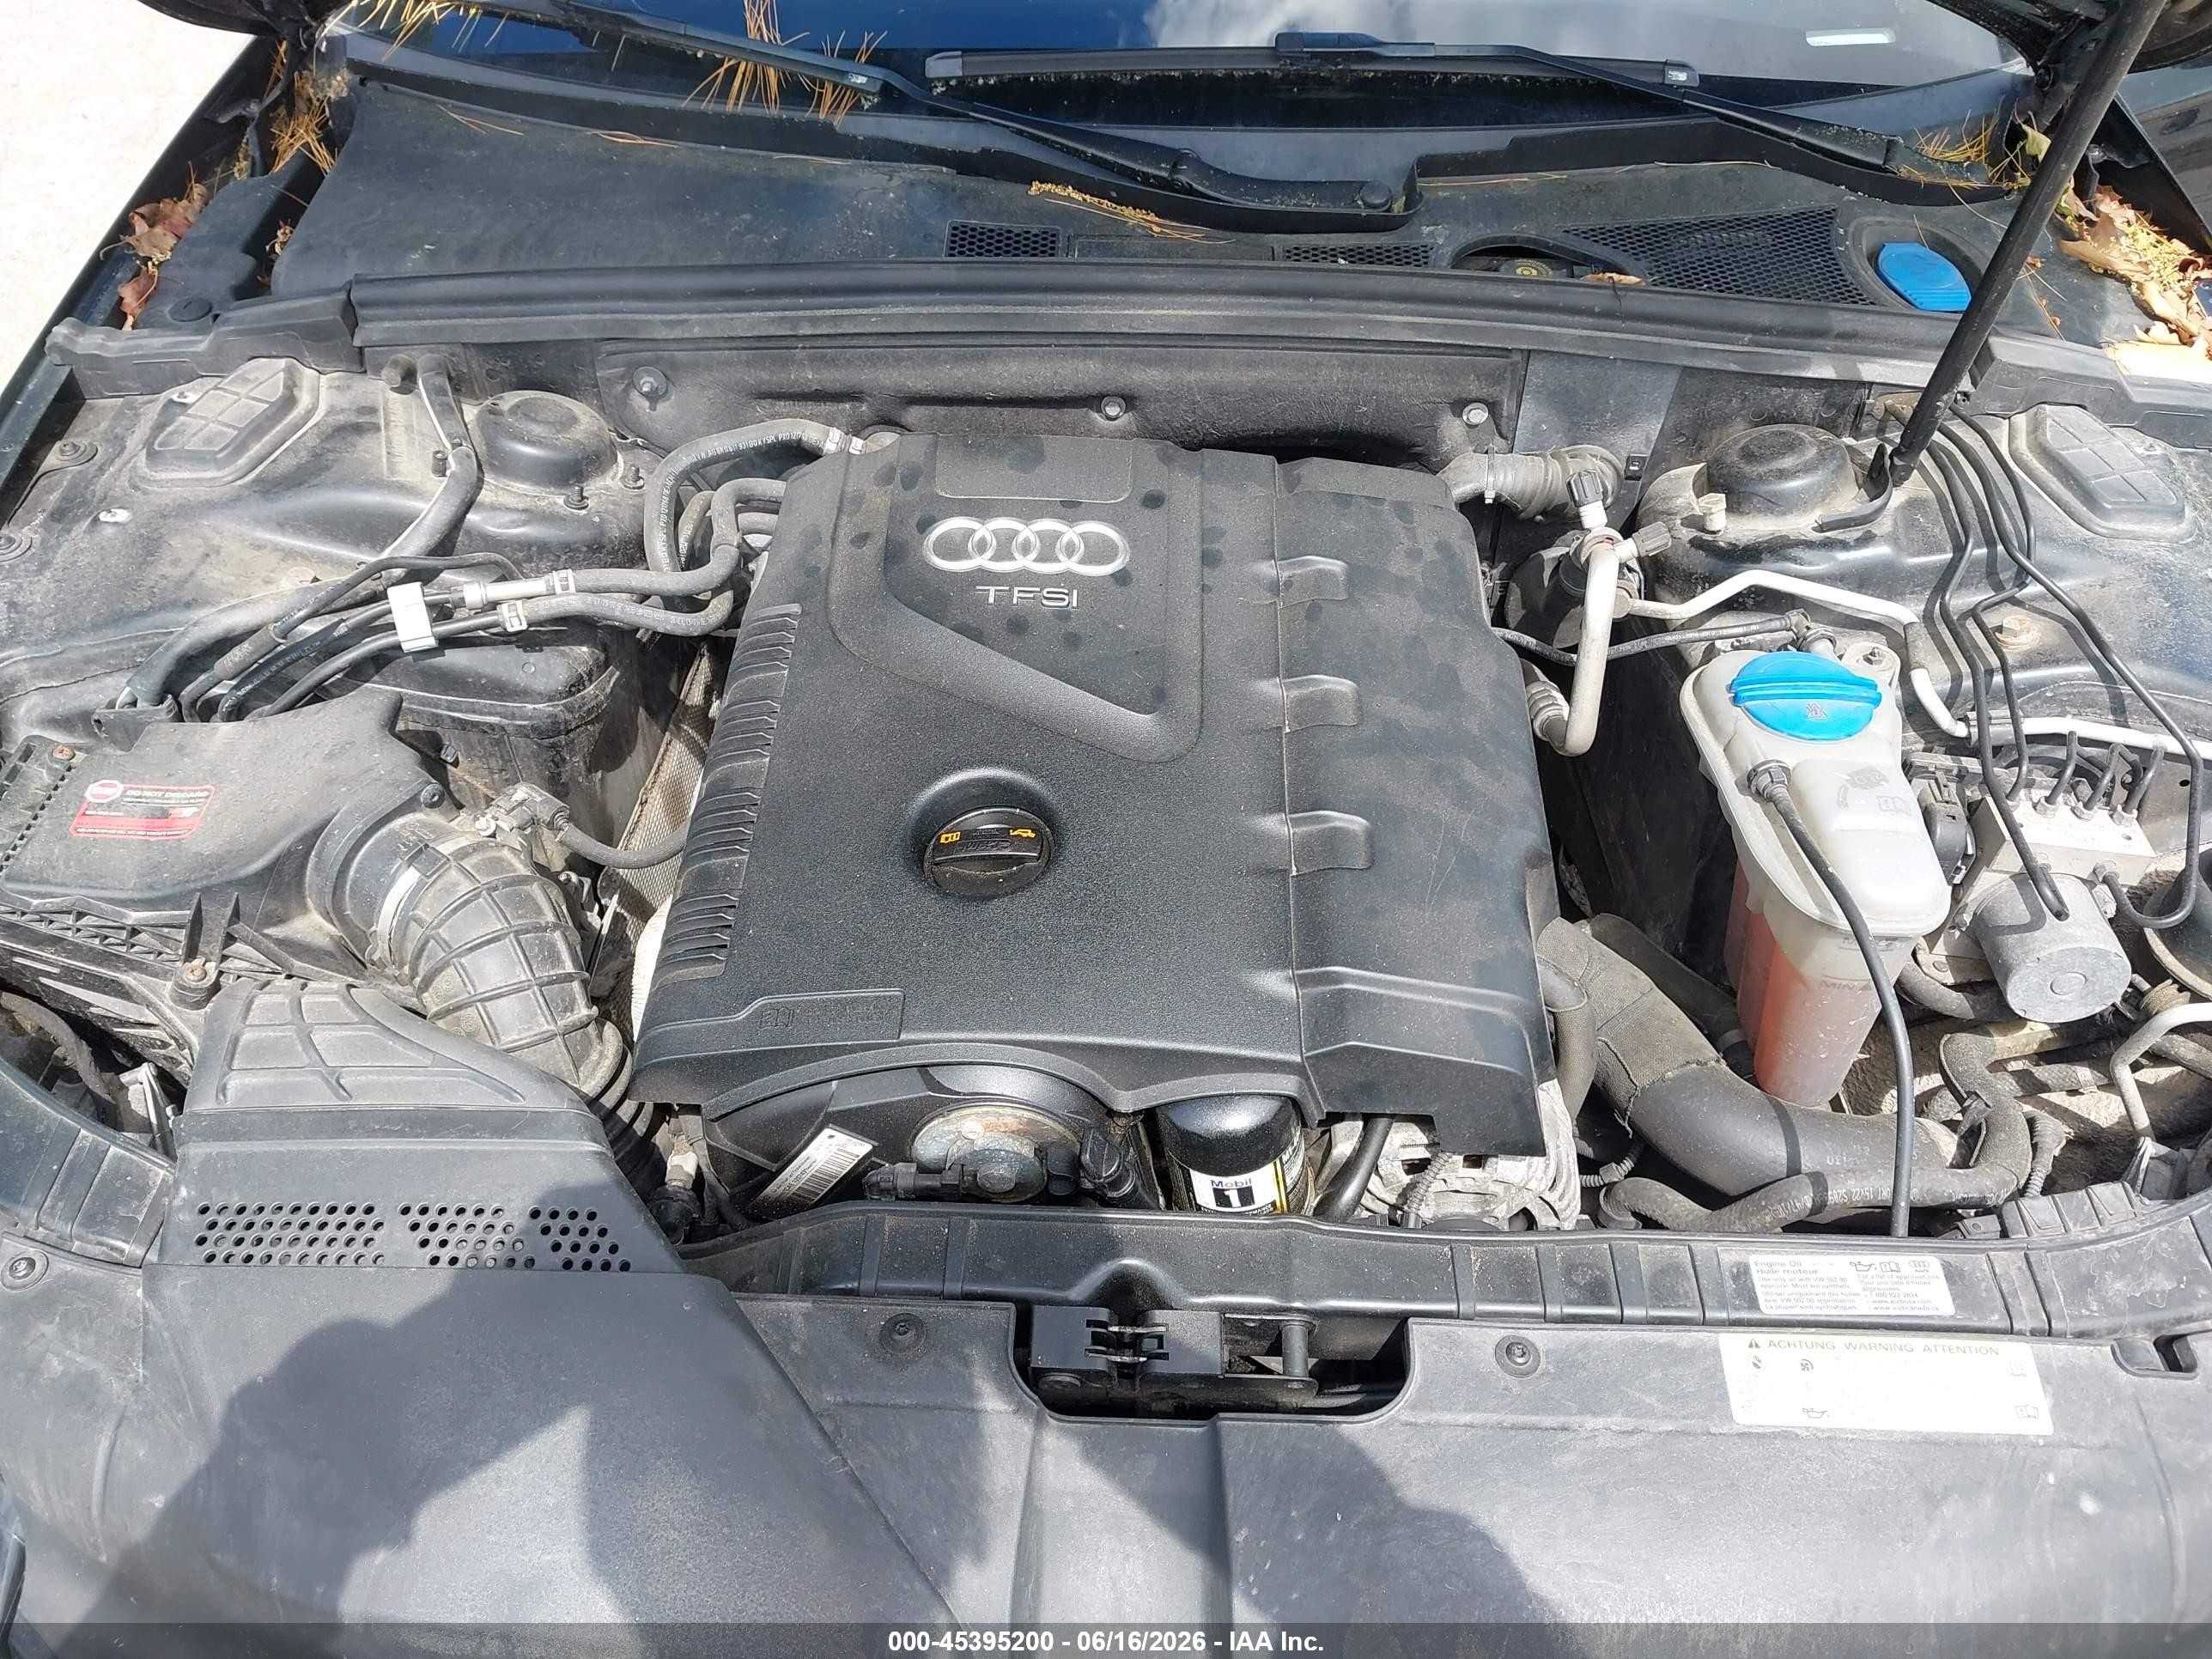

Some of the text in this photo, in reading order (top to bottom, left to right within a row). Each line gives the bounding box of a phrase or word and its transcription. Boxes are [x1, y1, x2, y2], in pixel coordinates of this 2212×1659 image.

[975, 586, 1079, 609] TFSI
[1210, 1178, 1252, 1188] Mobil
[1224, 1189, 1243, 1208] 1
[1754, 1260, 1787, 1268] Engine
[1767, 1340, 2000, 1356] ACHTUNG WARNING ATTENTION
